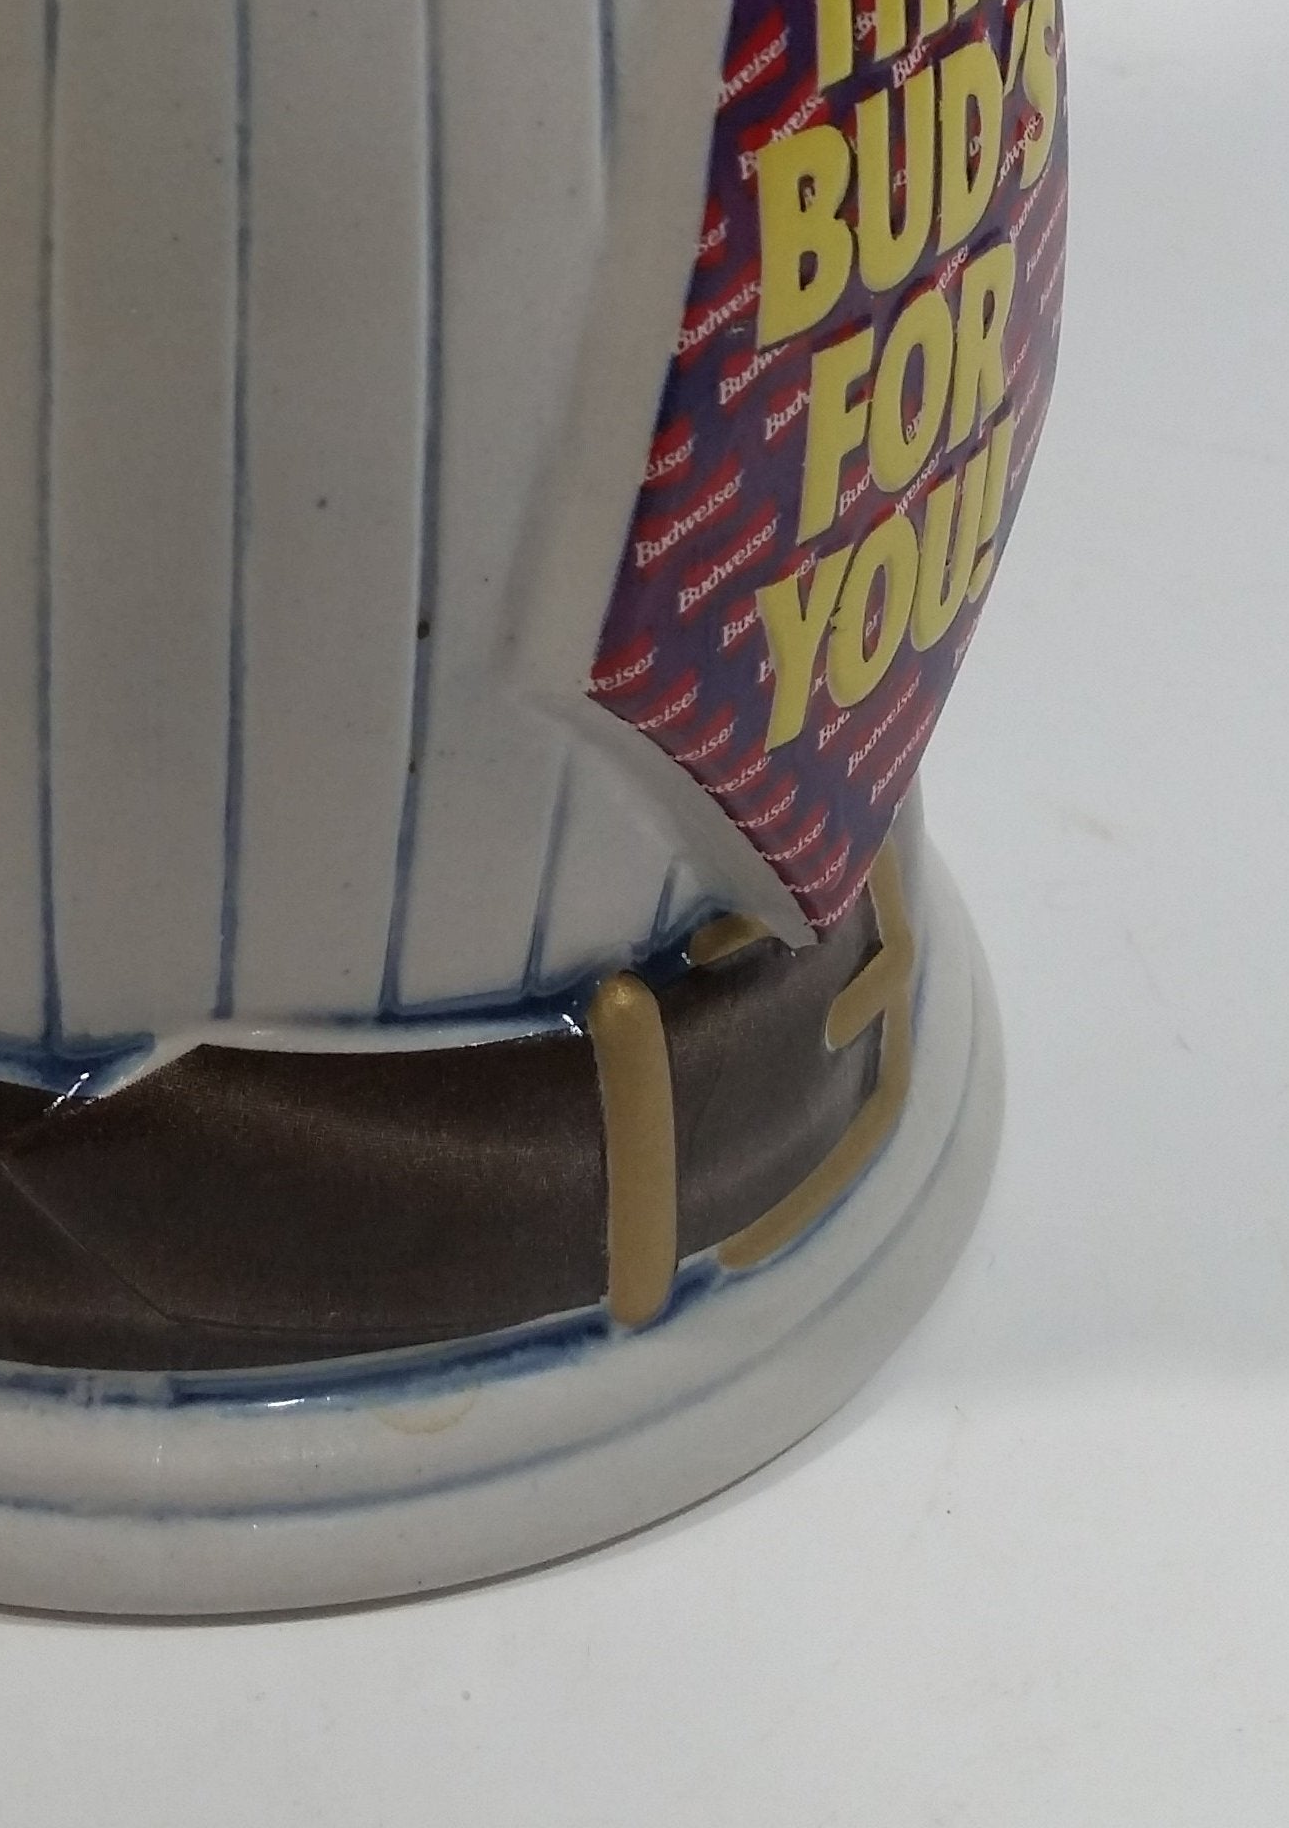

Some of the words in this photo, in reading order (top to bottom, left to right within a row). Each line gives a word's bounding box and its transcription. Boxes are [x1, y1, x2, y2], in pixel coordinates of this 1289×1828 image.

[798, 242, 1016, 545] FOR
[635, 469, 744, 568] Budweiser
[678, 514, 781, 613] Budweiser
[755, 413, 1015, 753] YOU!
